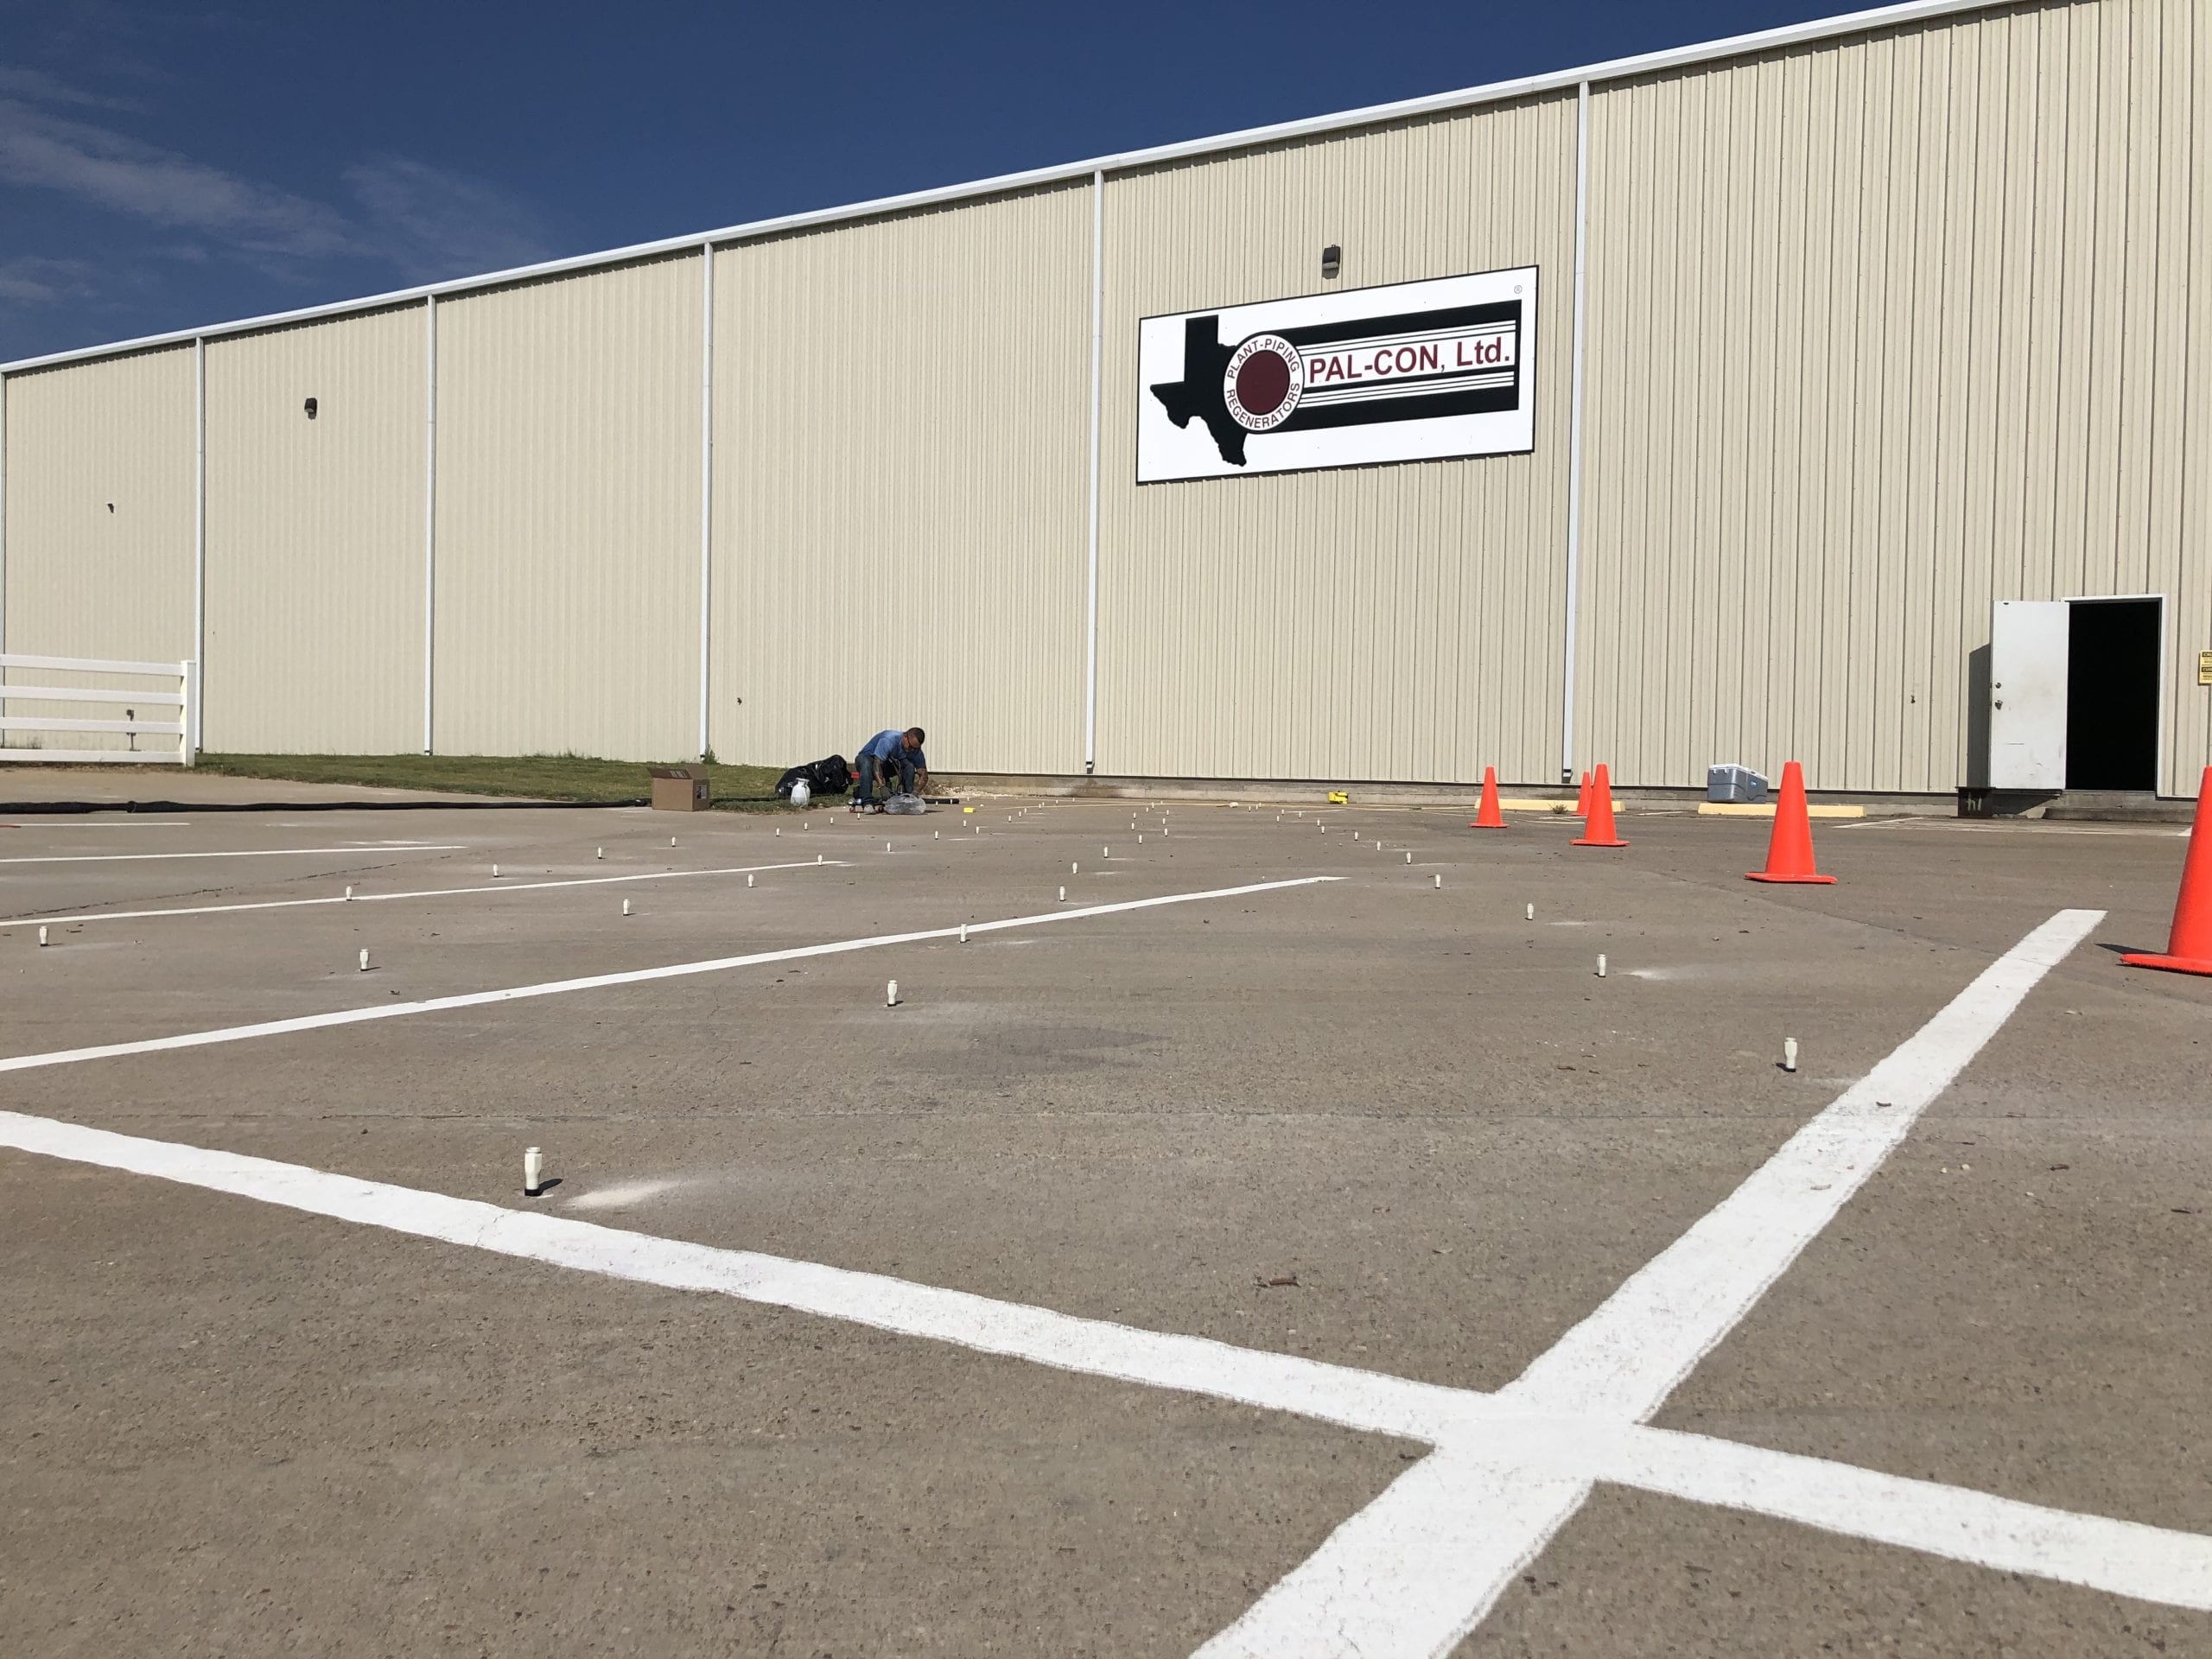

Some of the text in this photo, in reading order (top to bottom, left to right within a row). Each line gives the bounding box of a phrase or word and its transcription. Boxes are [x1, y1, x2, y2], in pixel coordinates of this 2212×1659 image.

[1227, 338, 1300, 379] PLANT-PIPING
[1310, 336, 1510, 384] PAL-CON, Ltd.
[1226, 382, 1300, 429] REGENERATORS
